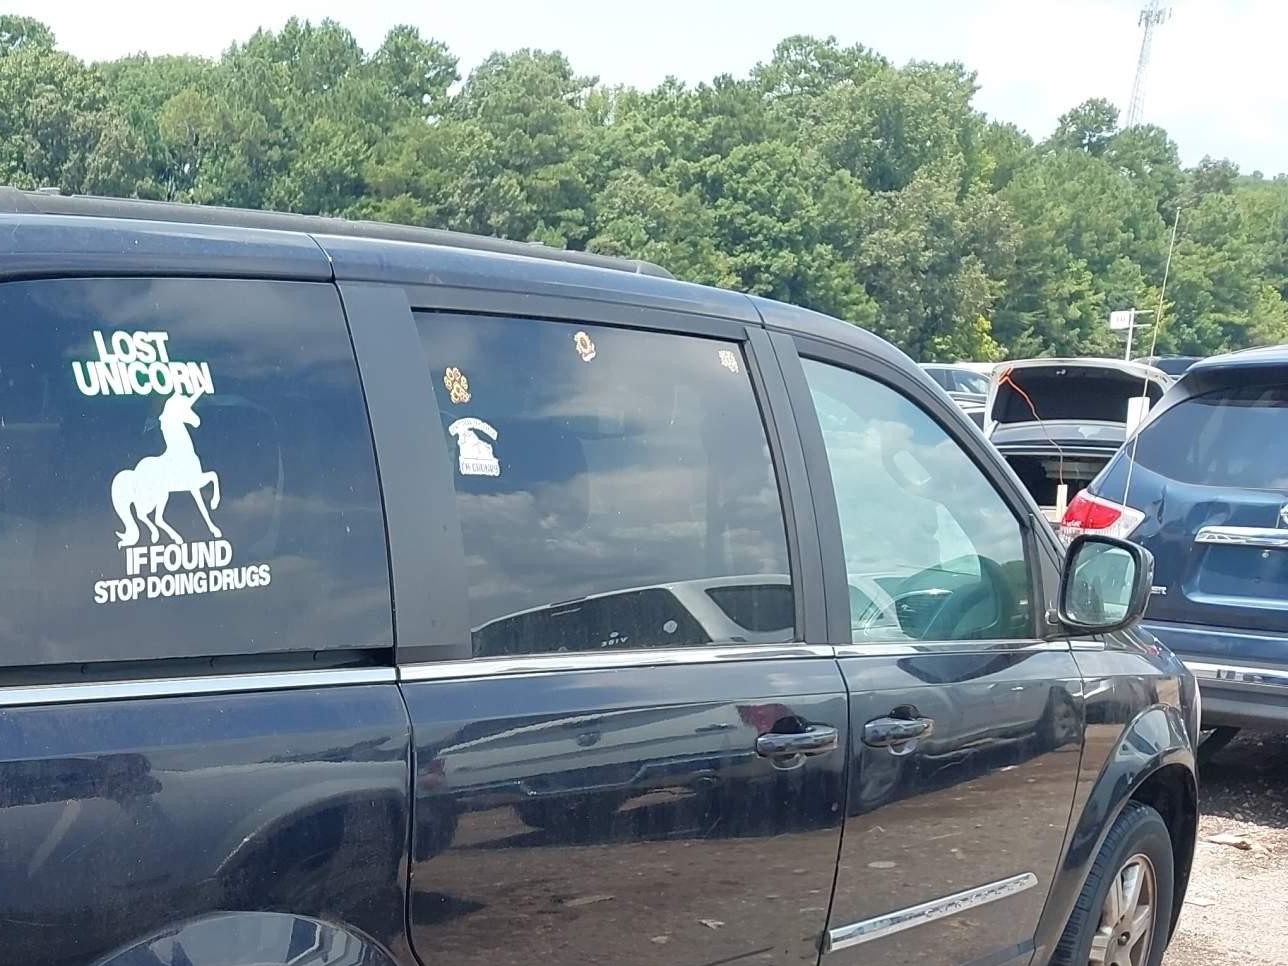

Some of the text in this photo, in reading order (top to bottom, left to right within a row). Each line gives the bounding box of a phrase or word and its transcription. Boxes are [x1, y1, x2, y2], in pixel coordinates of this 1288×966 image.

[93, 330, 169, 363] LOST
[72, 361, 214, 395] UNICORN
[125, 540, 233, 575] IF FOUND
[94, 564, 271, 604] STOP DOING DRUGS
